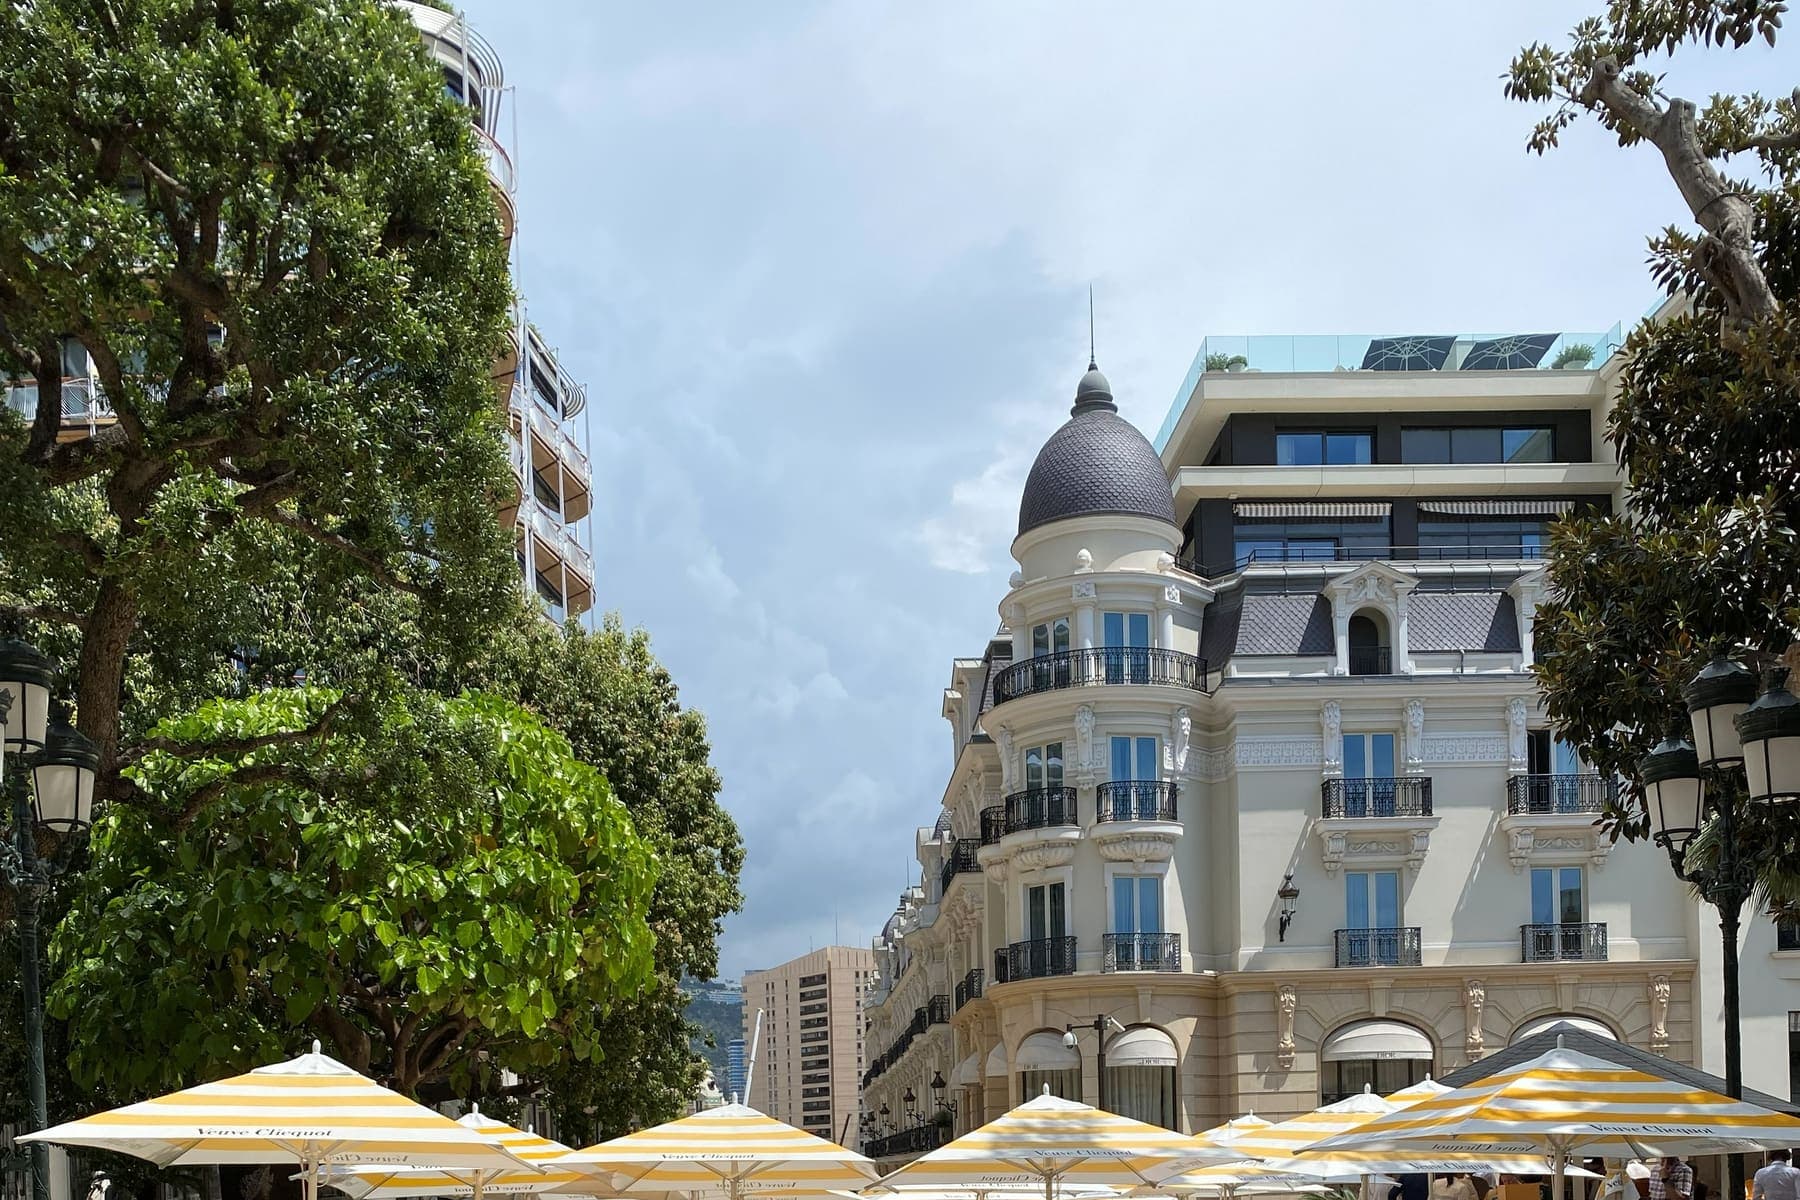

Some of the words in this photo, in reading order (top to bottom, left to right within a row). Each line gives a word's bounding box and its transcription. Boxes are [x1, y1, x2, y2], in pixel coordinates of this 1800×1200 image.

[198, 1128, 249, 1136] Veuve
[255, 1128, 332, 1137] Clicquot
[1590, 1123, 1639, 1133] Veuve
[1642, 1124, 1713, 1135] Clicquot
[1034, 1149, 1073, 1157] Veuve
